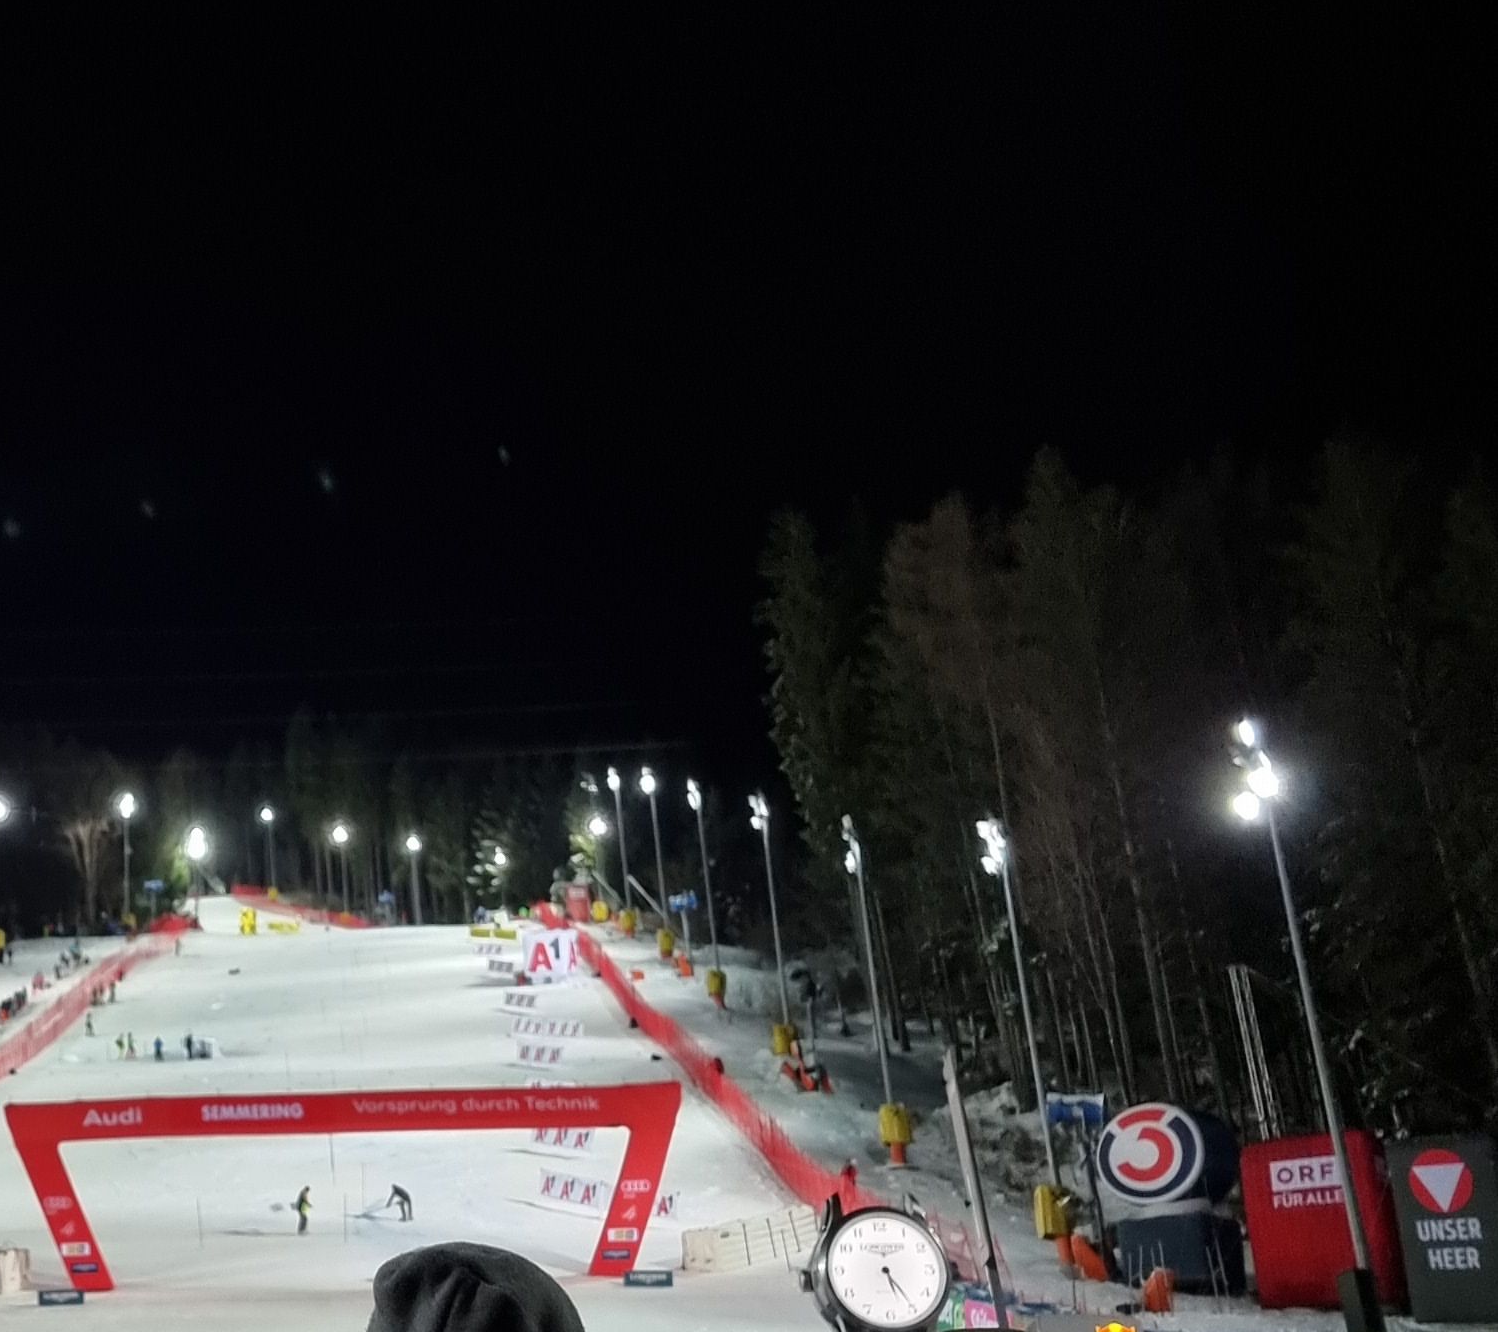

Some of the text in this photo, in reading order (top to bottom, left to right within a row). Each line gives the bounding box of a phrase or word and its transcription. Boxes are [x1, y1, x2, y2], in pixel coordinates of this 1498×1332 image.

[528, 937, 560, 972] A1
[201, 1102, 304, 1122] SEMMERING
[352, 1095, 599, 1115] Vorsprung durch Technik
[83, 1106, 142, 1127] Audi
[1277, 1163, 1334, 1184] ORF
[580, 1184, 597, 1204] A1
[1273, 1188, 1345, 1209] FÜR ALLE
[657, 1194, 674, 1216] A1
[1415, 1218, 1482, 1242] UNSER
[1427, 1246, 1481, 1270] HEER
